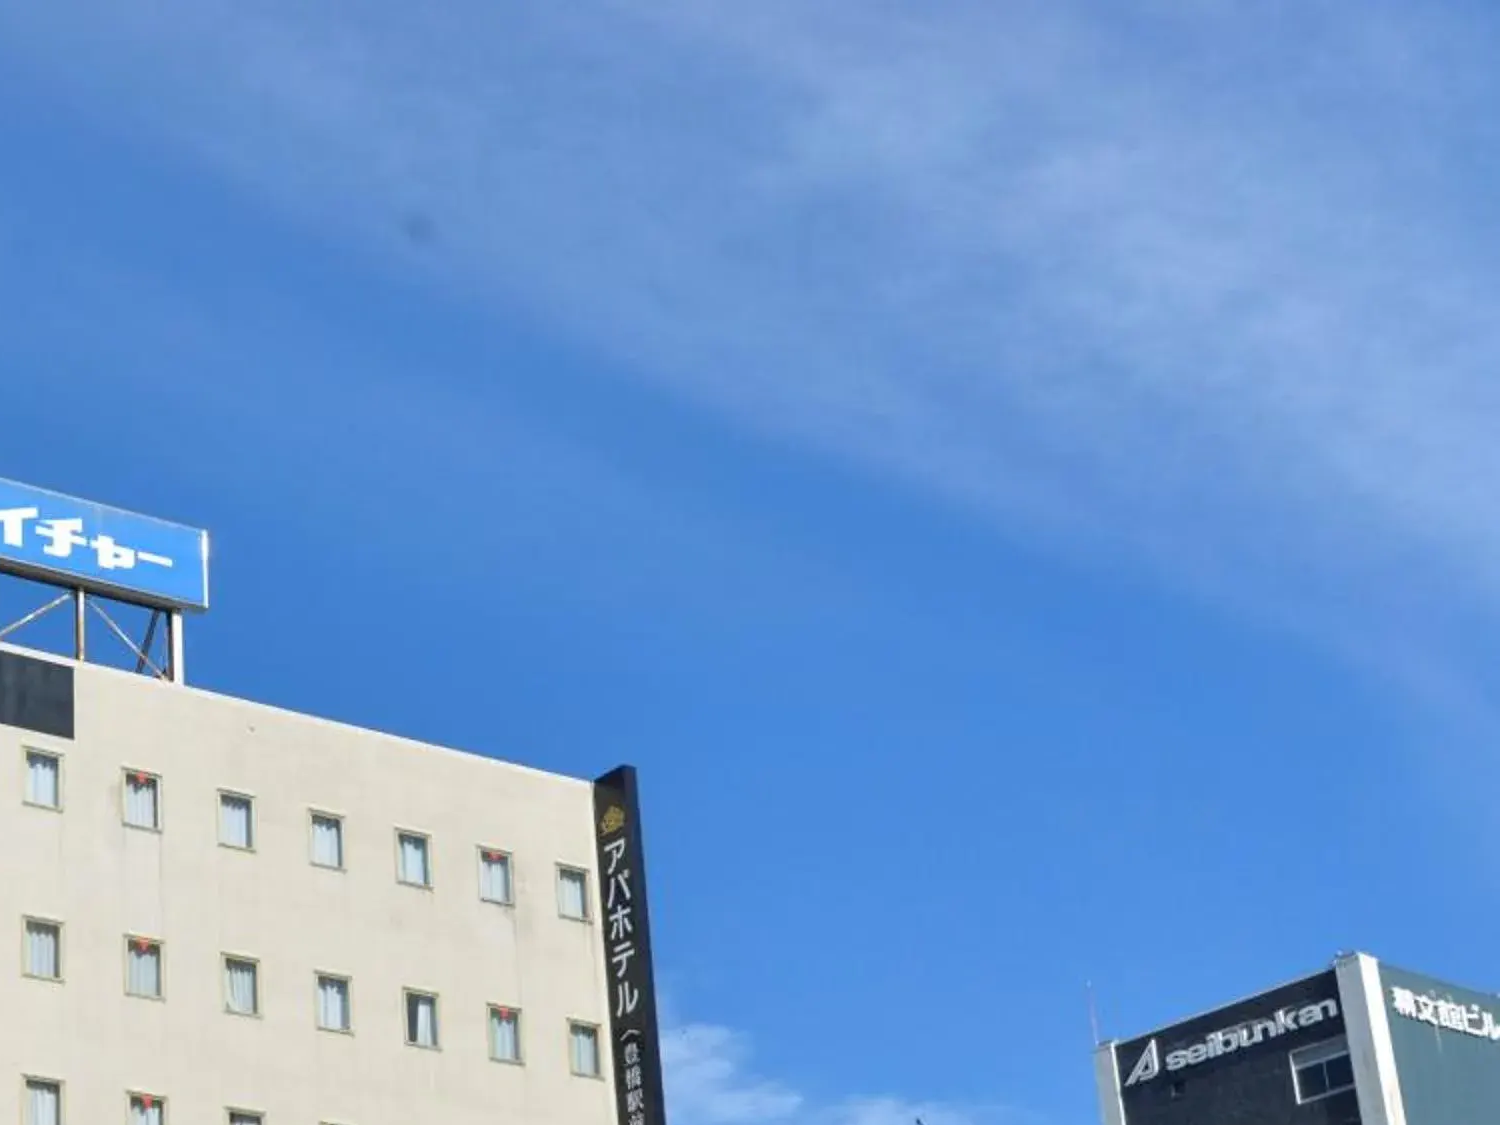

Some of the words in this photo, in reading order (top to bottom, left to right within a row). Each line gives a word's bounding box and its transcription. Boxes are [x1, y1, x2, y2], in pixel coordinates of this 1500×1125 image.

[603, 837, 639, 1018] アパホテル
[1165, 997, 1338, 1072] seibunkan
